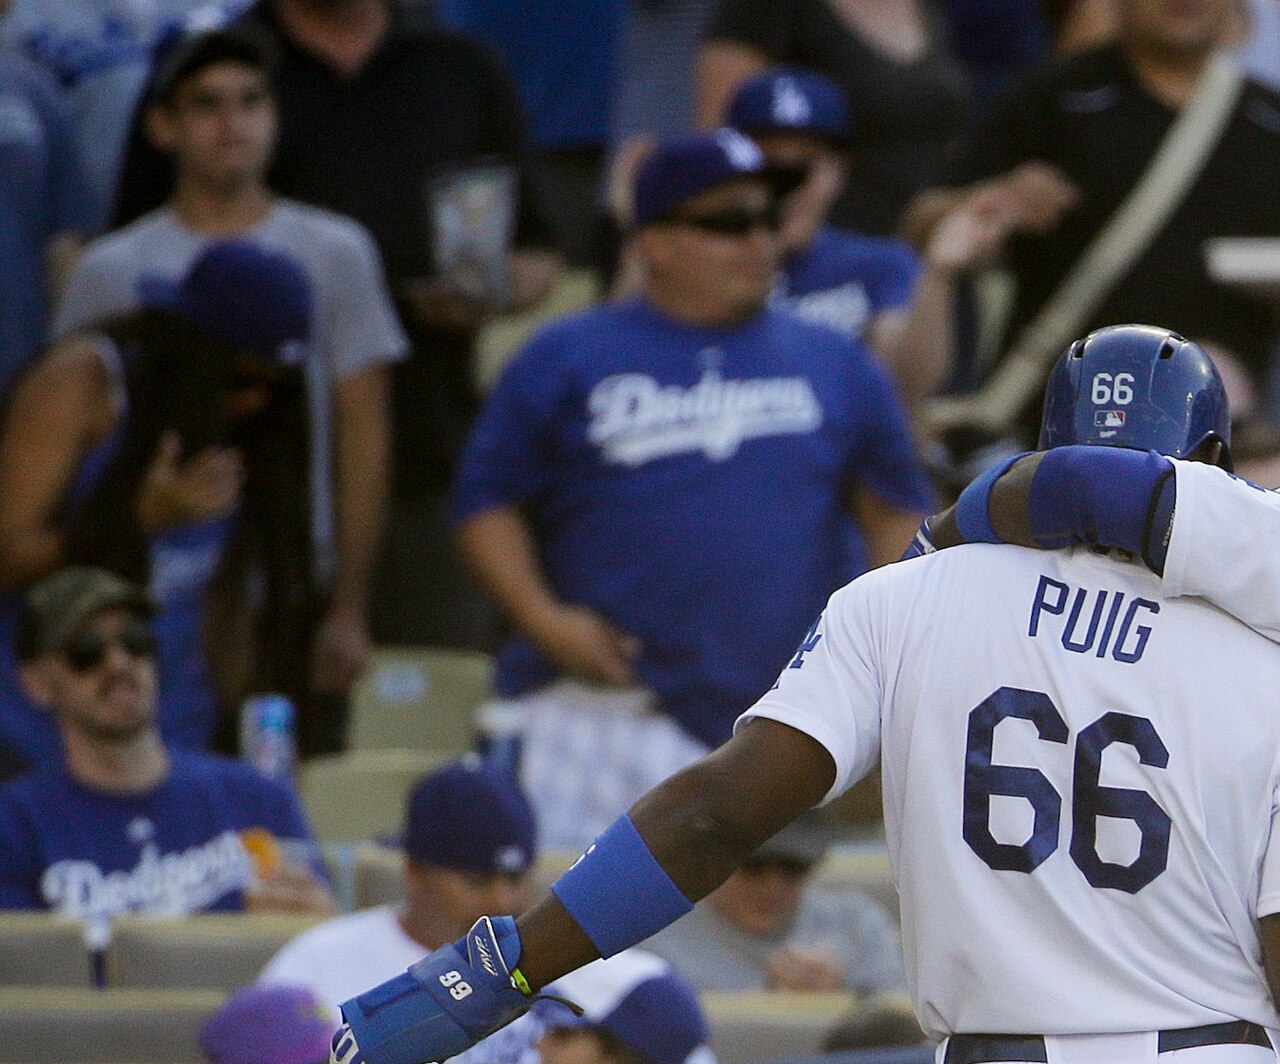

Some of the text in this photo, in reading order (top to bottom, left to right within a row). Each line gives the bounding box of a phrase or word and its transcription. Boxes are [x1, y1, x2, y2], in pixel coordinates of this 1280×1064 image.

[1091, 372, 1135, 405] 66
[1028, 574, 1160, 664] PUIG
[962, 686, 1172, 895] 66
